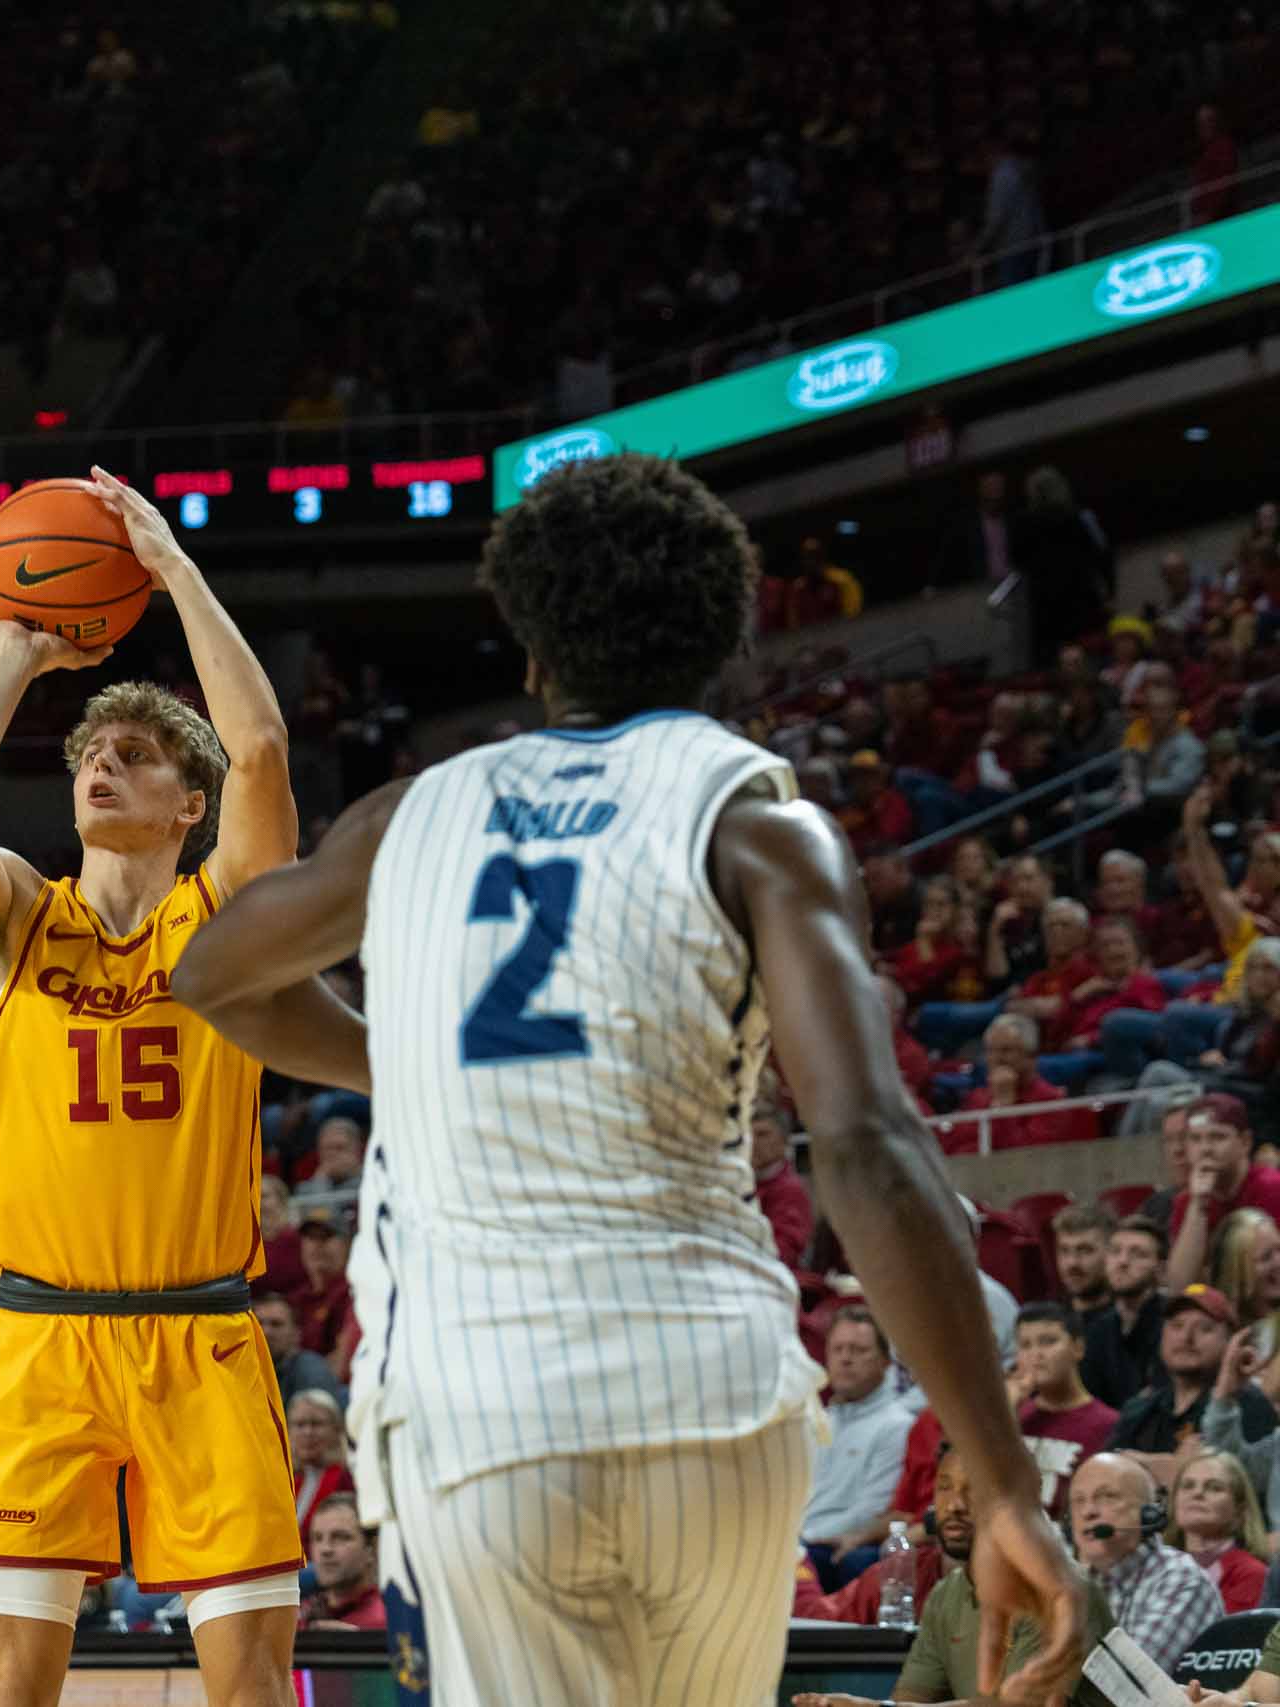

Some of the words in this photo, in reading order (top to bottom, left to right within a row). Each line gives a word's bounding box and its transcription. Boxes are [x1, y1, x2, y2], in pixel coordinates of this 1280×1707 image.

[36, 966, 173, 1019] Cyclon
[459, 850, 593, 1068] 2
[68, 1026, 182, 1123] 15
